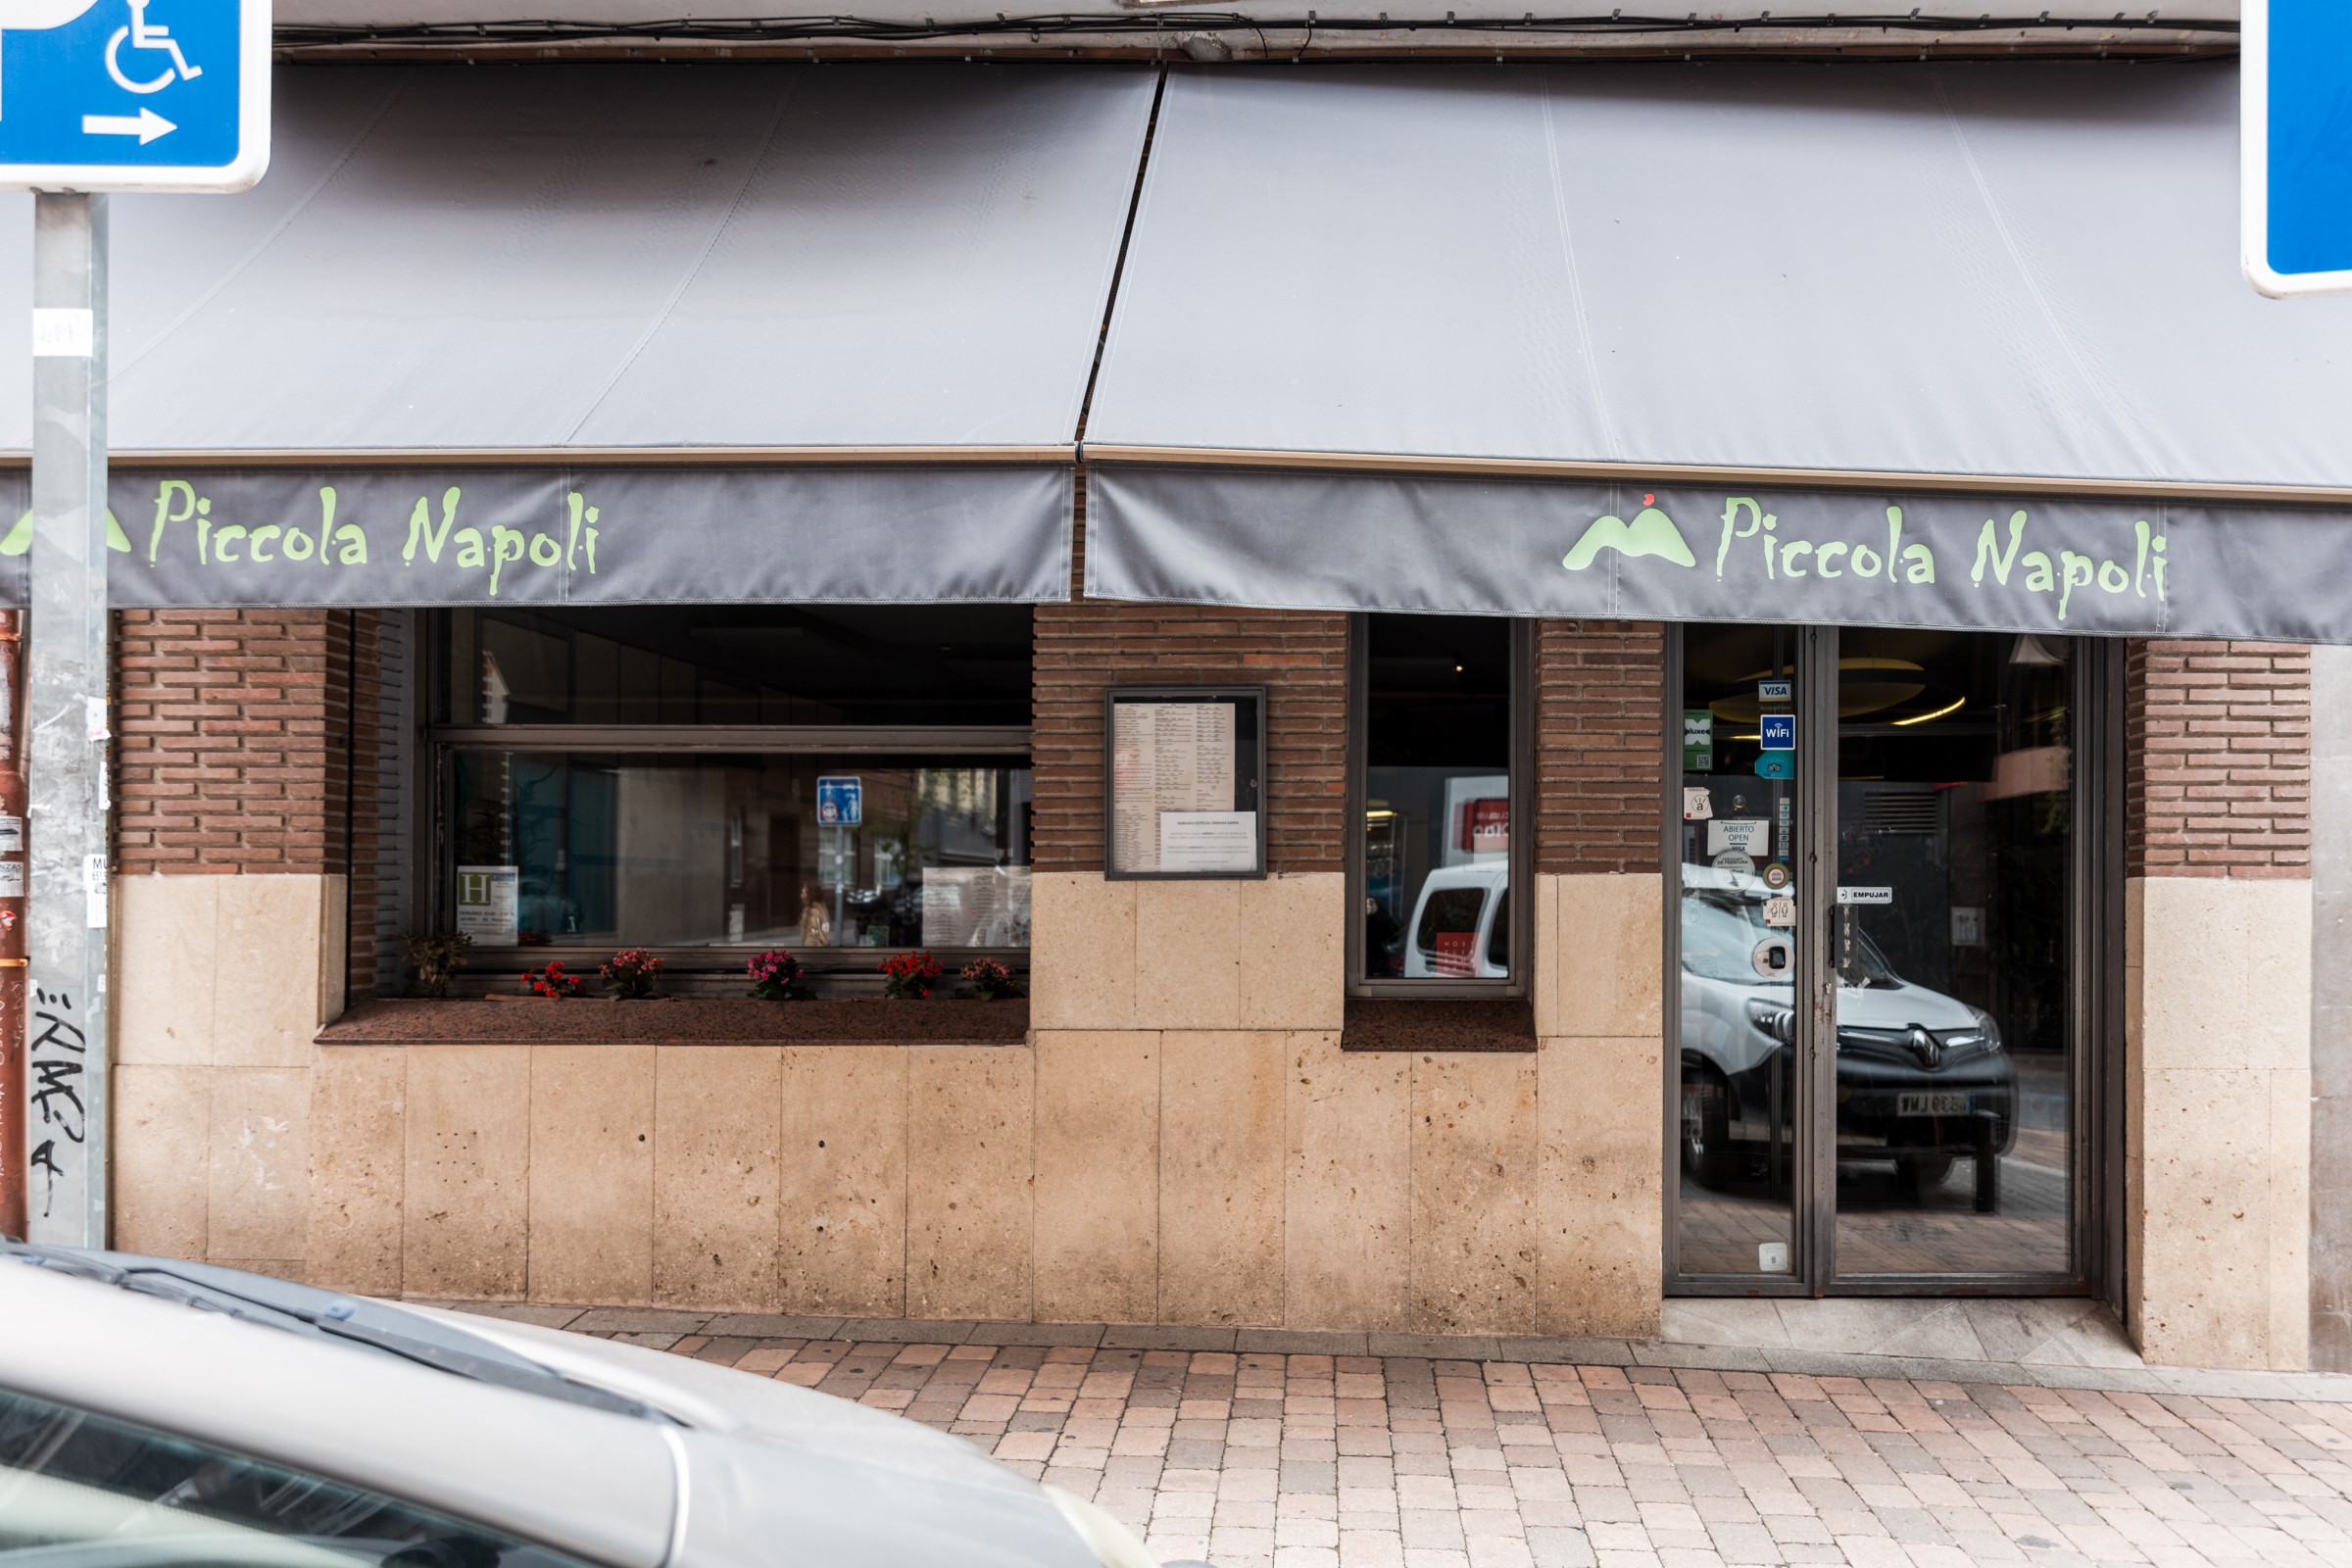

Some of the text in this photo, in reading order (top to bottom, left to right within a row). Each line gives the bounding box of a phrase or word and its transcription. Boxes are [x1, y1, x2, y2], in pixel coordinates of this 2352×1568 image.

[149, 479, 600, 596] Piccola Napoli
[1715, 497, 2168, 619] Piccola Napoli
[1685, 727, 1710, 736] pluxee
[462, 874, 490, 903] H
